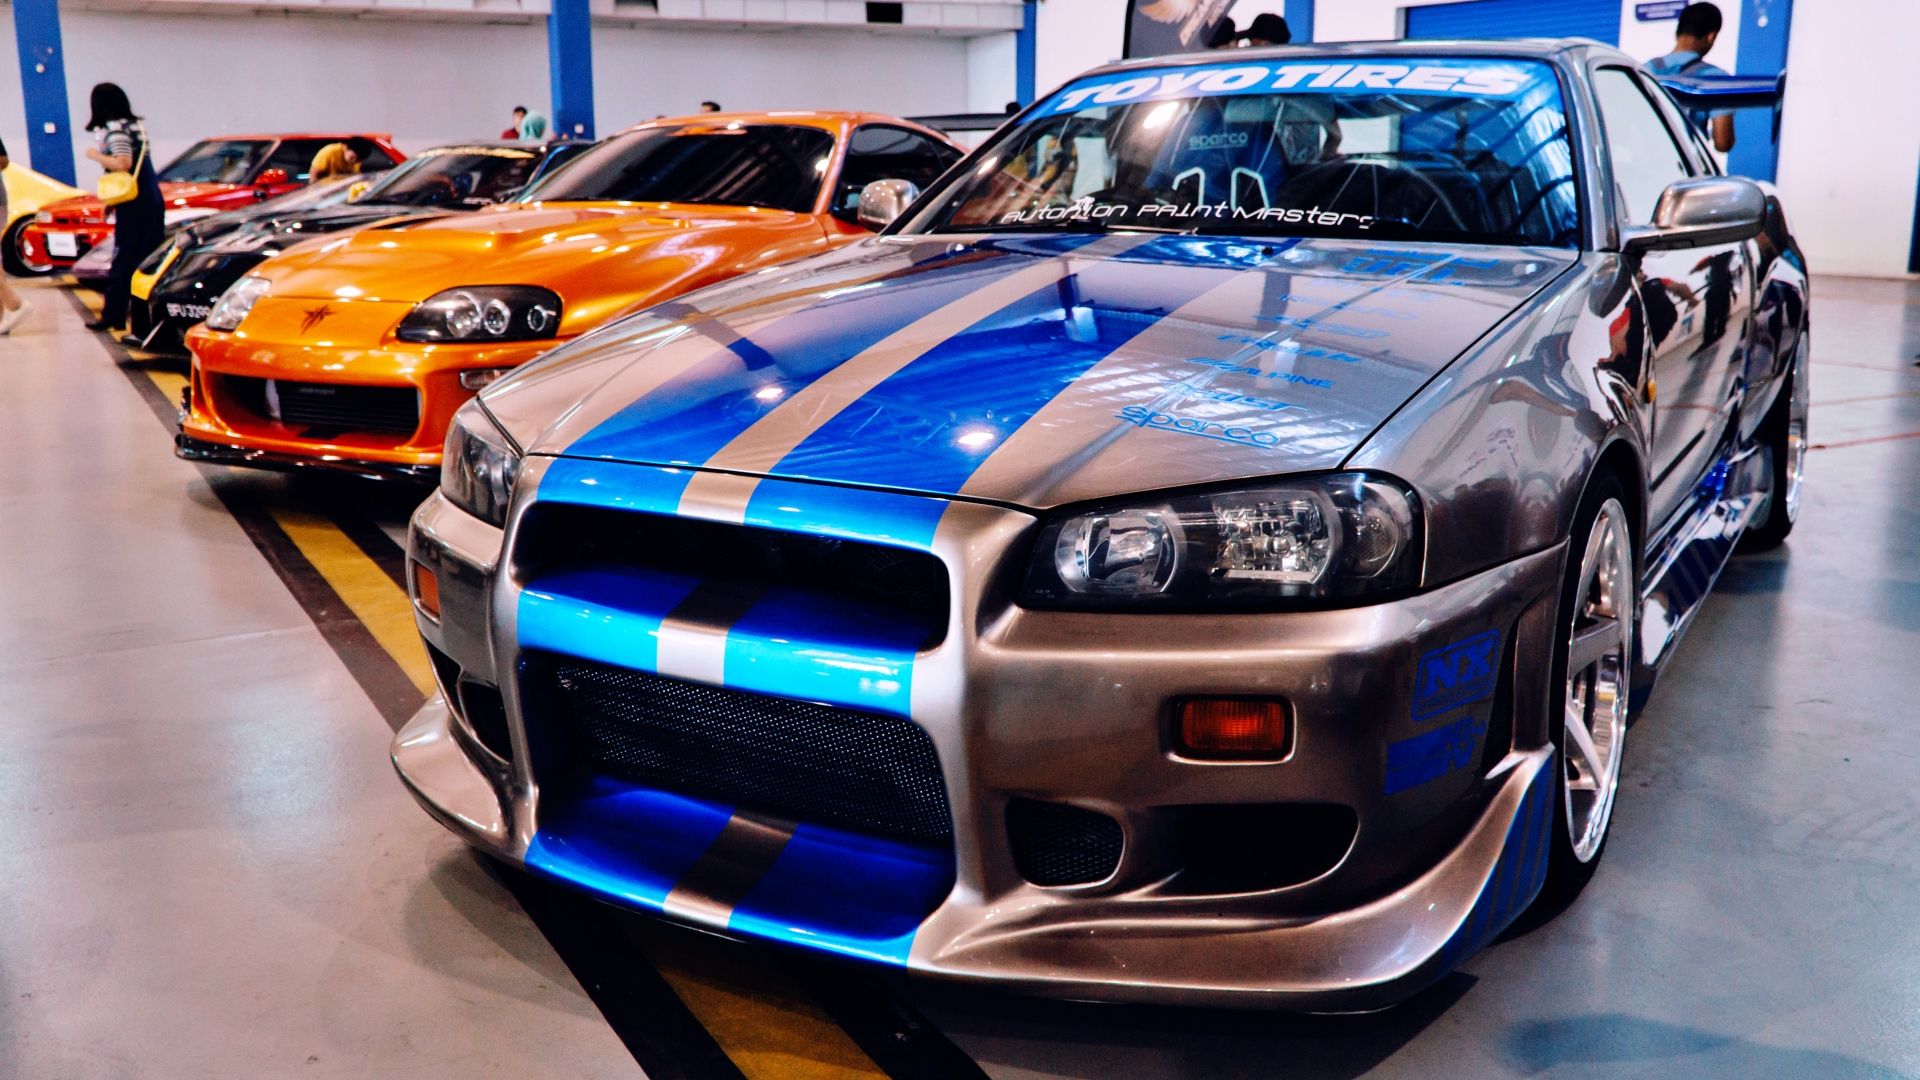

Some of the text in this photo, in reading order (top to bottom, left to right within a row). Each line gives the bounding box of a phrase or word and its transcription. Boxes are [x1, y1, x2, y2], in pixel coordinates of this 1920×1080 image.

[1055, 64, 1532, 111] TOYO TIRES
[1117, 405, 1281, 445] sparco
[1422, 638, 1495, 698] NX
